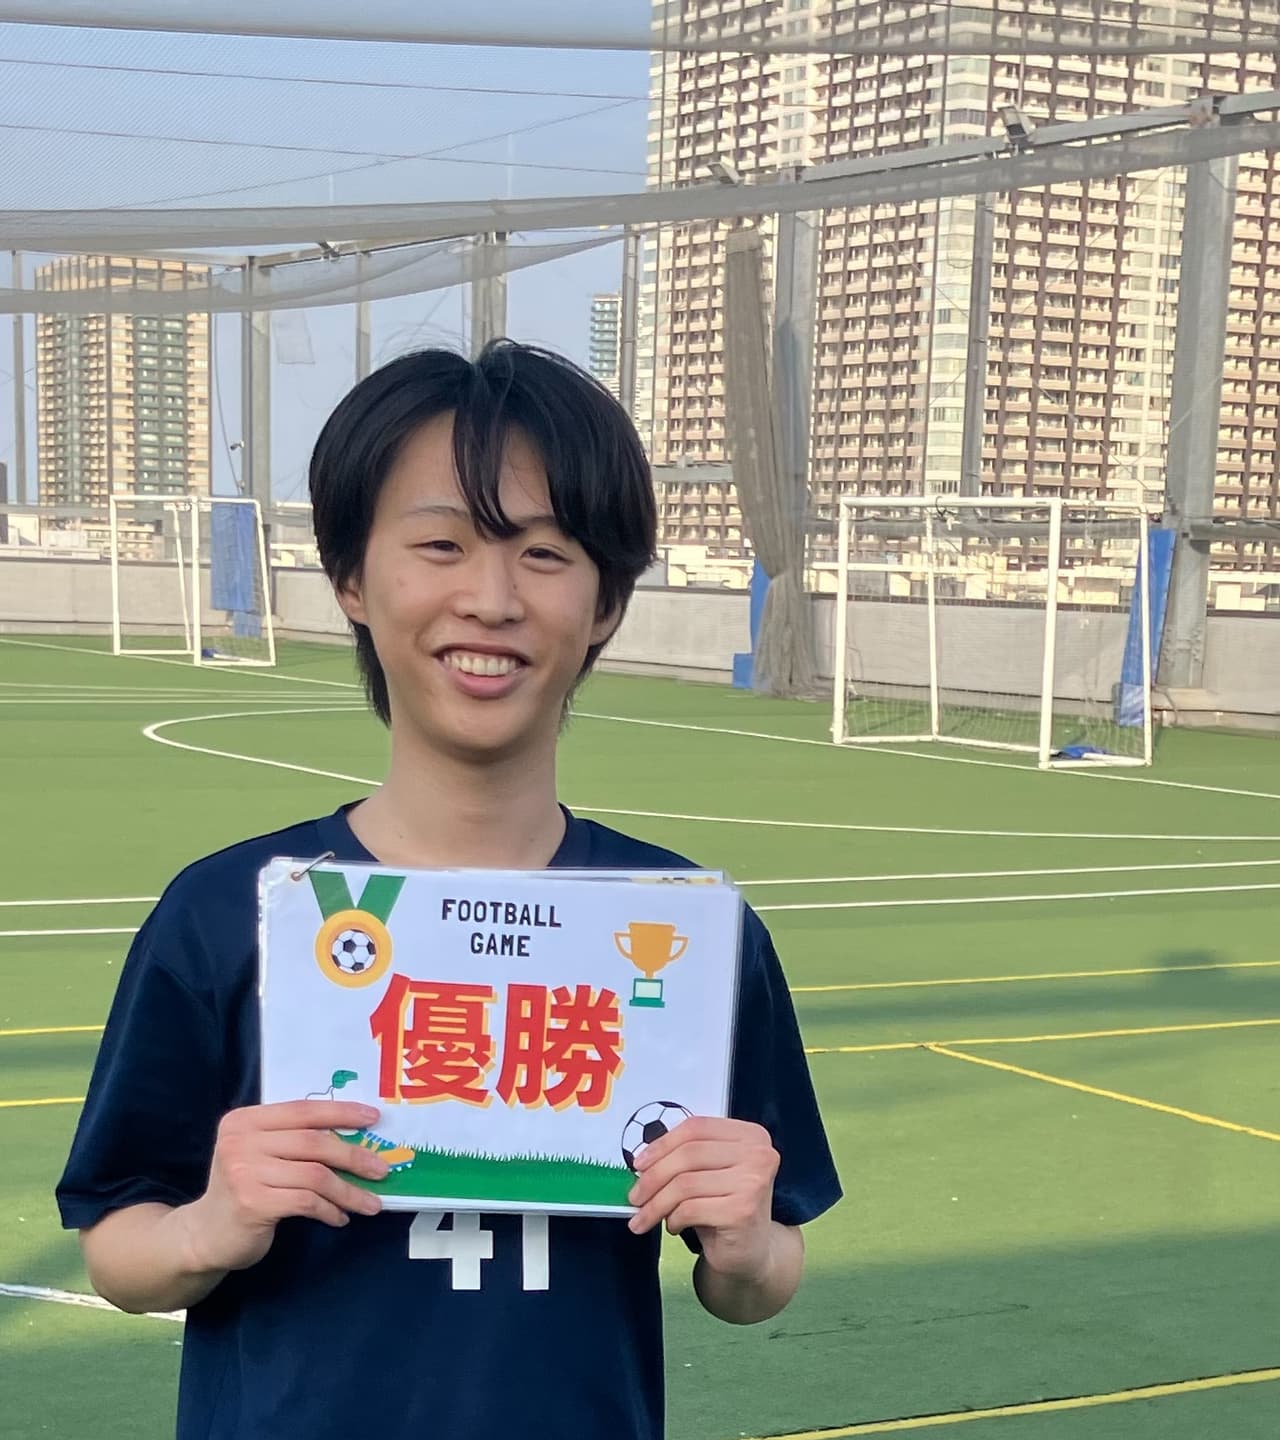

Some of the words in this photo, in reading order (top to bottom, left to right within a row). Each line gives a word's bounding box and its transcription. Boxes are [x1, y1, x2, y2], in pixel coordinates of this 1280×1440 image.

[441, 898, 563, 929] FOOTBALL
[470, 931, 531, 957] GAME
[369, 972, 626, 1113] 優勝
